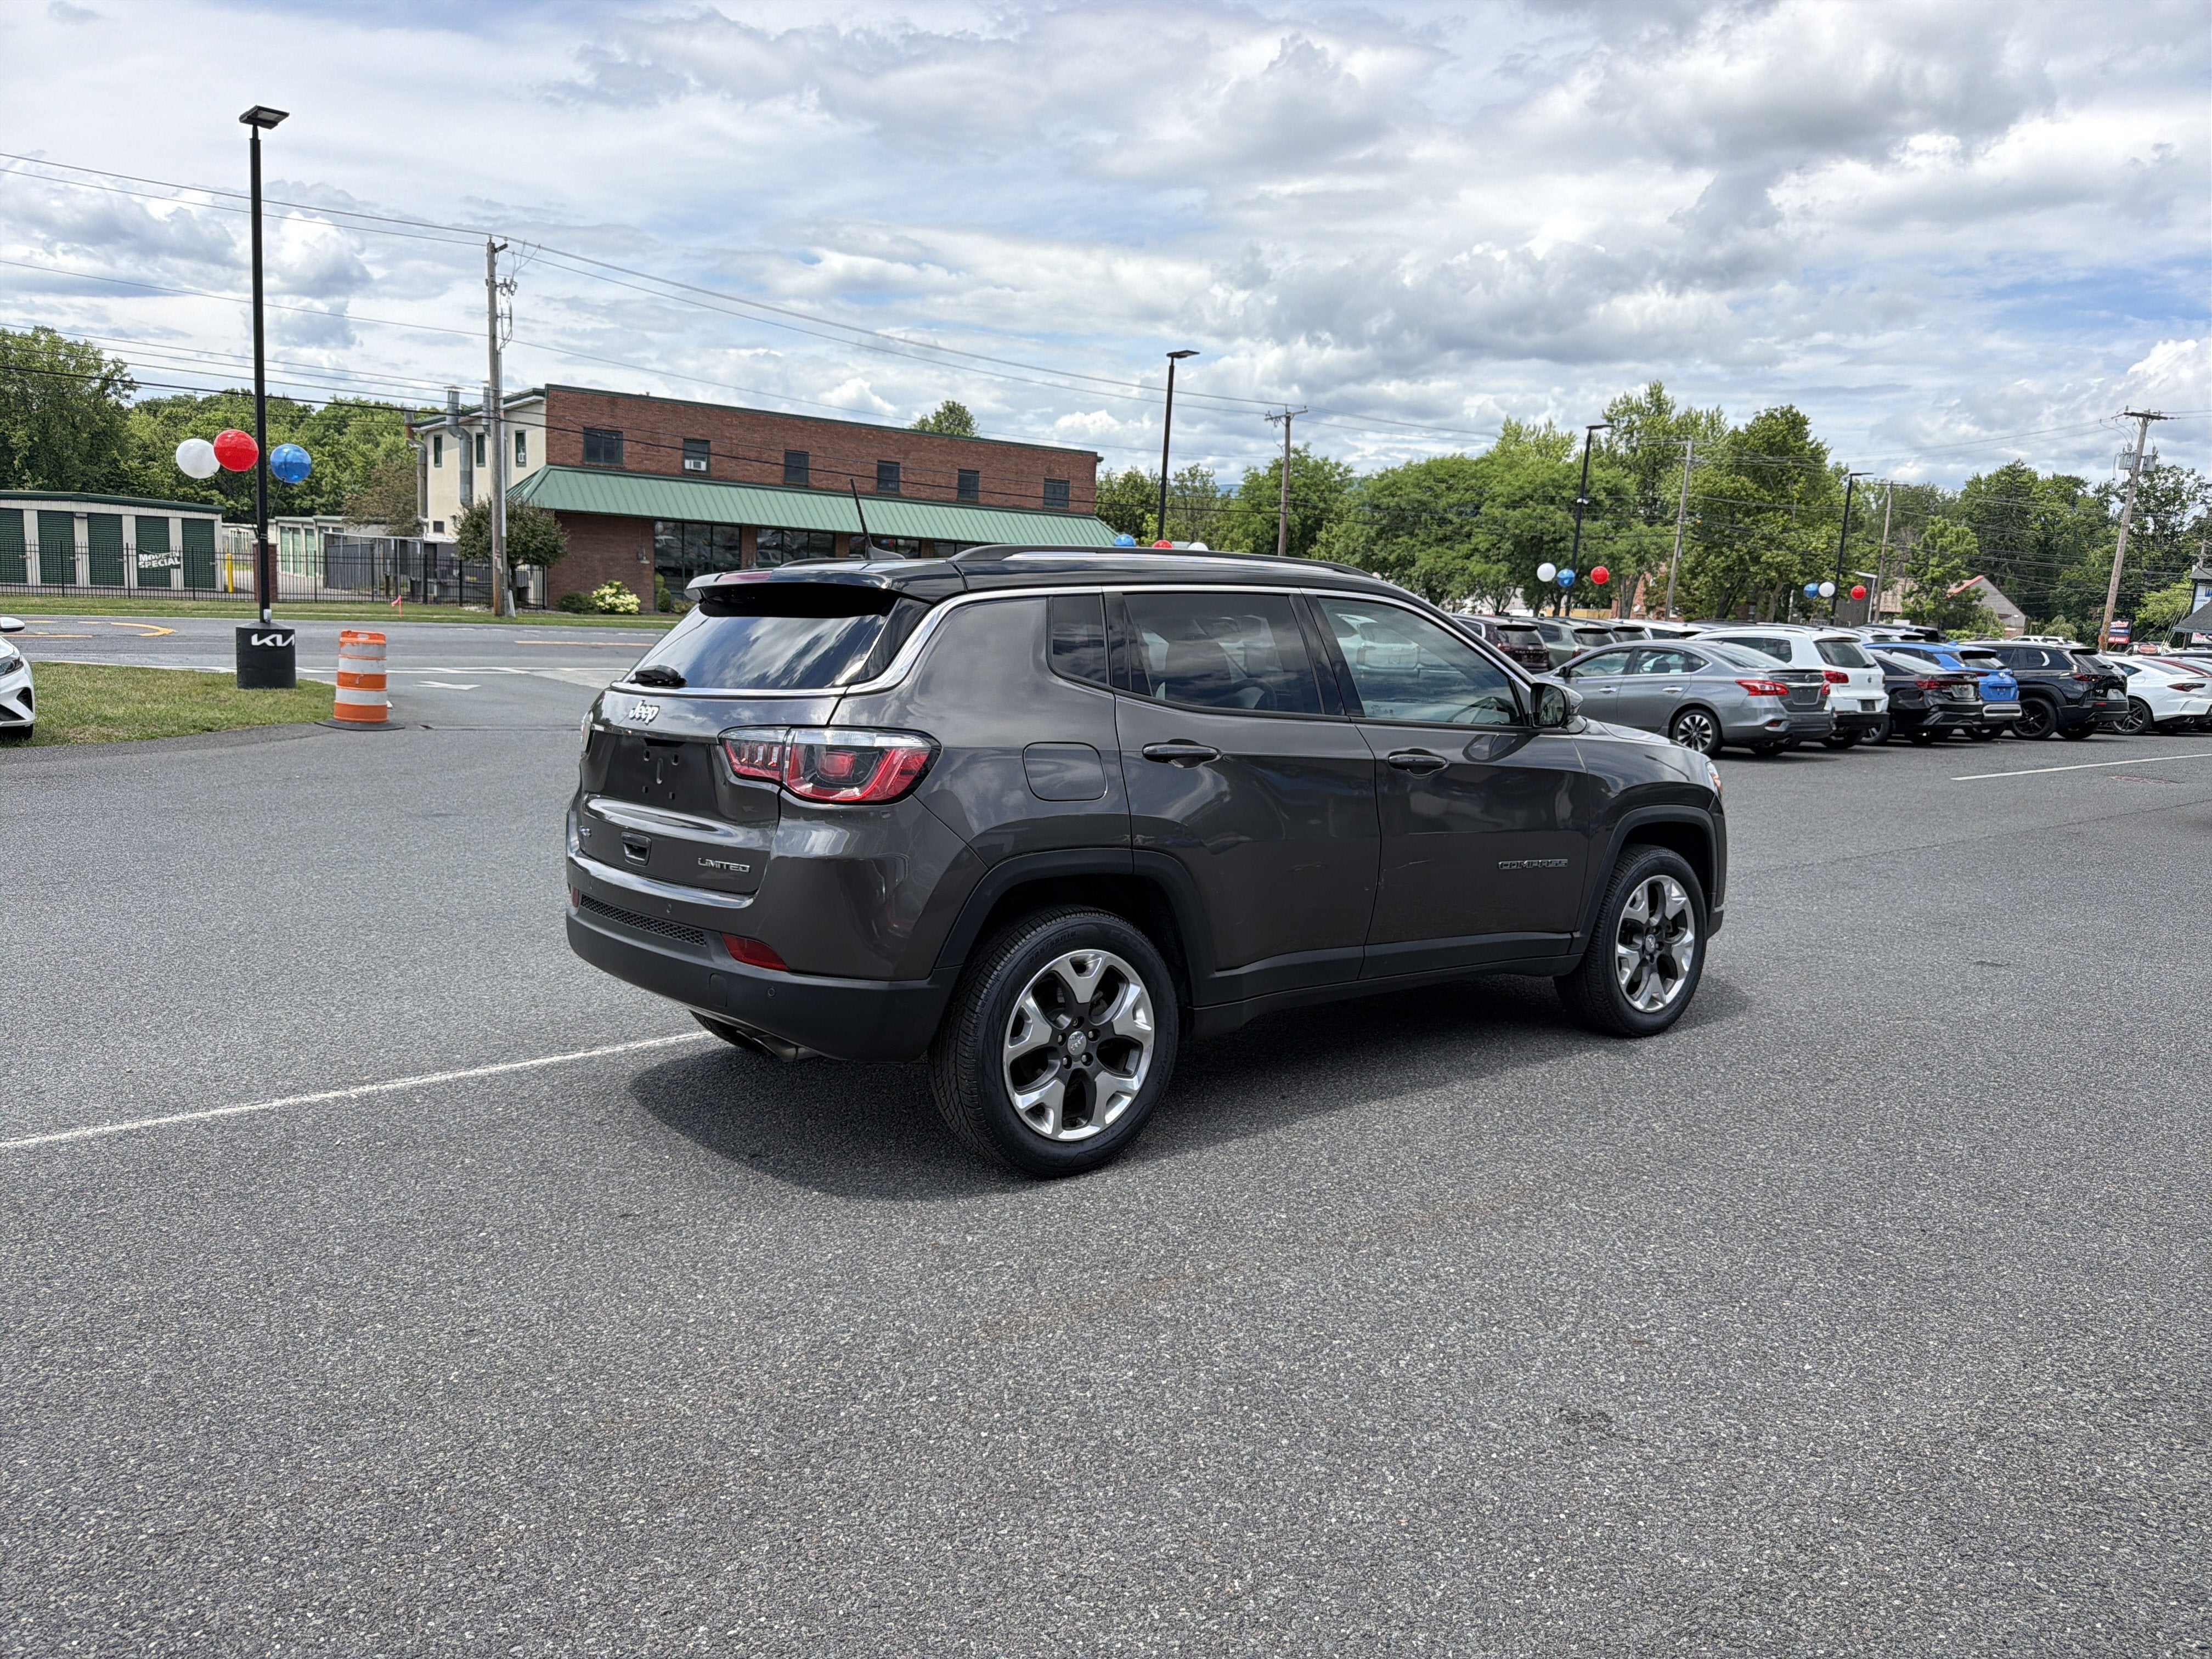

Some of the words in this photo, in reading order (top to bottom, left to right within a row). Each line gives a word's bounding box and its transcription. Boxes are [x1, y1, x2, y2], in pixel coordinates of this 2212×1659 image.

[138, 557, 180, 568] SPECIAL
[629, 701, 659, 724] Jeep
[698, 857, 750, 873] LIMITED
[1499, 859, 1568, 870] COMPASS
